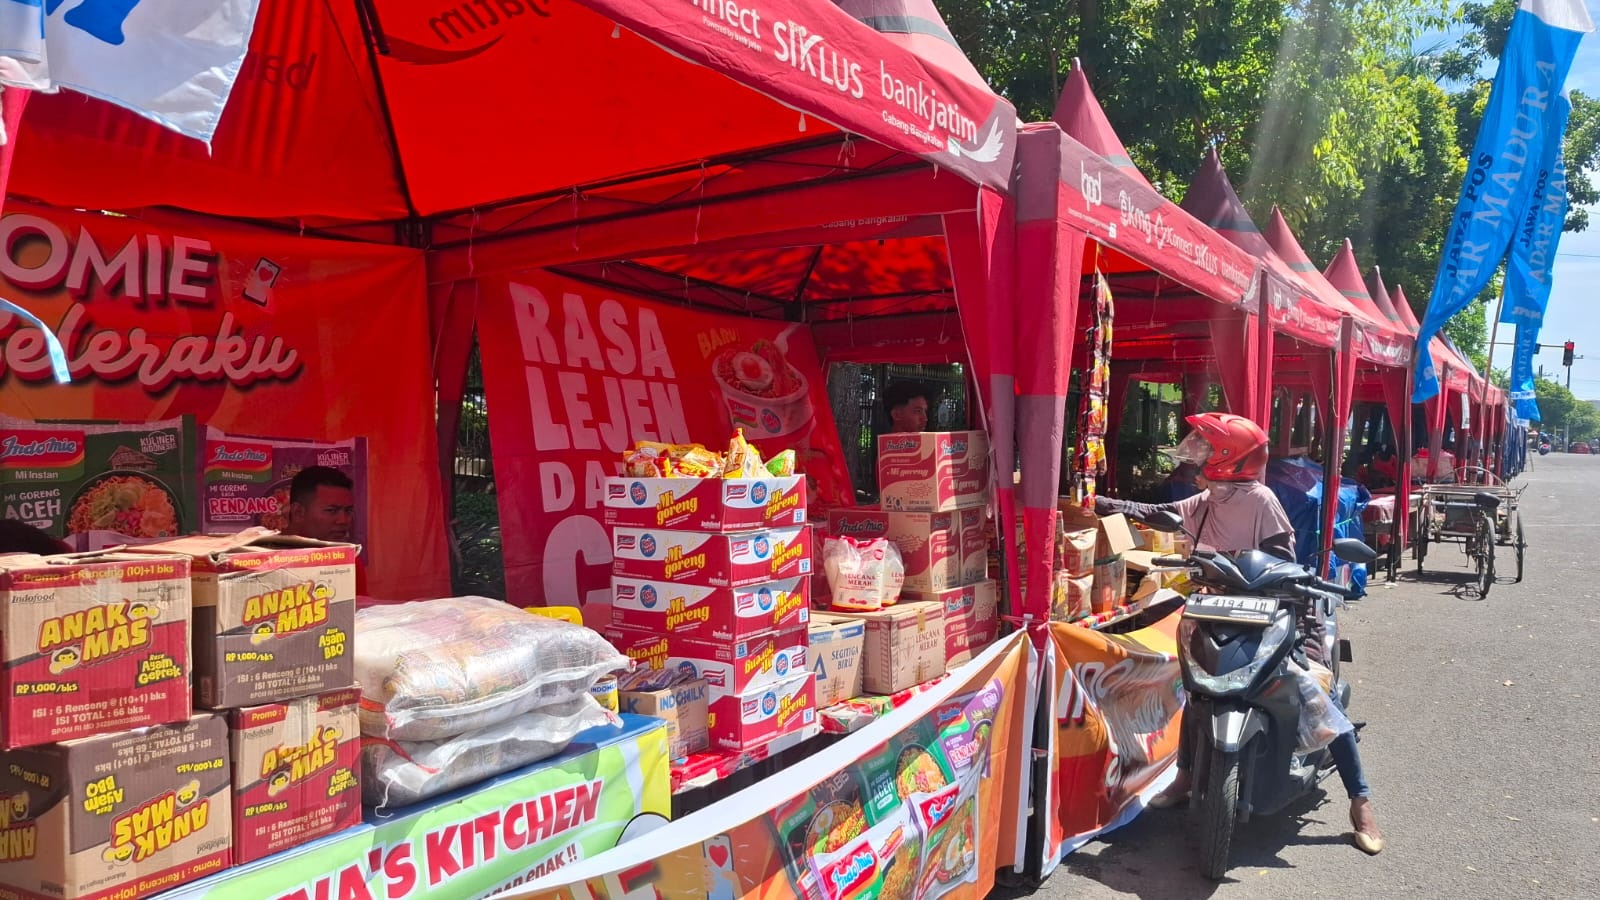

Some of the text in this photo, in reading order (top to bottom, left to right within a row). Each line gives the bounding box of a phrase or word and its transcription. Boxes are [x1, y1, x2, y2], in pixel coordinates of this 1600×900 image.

[880, 60, 977, 145] bankjatim
[882, 110, 944, 149] Cabang Bangkalan
[1473, 61, 1556, 230] MADURA
[1446, 152, 1493, 279] JAWA POS
[1520, 169, 1548, 248] JAWA POS
[509, 282, 675, 379] RASA
[697, 328, 741, 359] BARU!
[526, 366, 691, 455] LEJEN
[140, 434, 175, 447] KULINER
[15, 471, 58, 479] Mi Instan
[19, 489, 61, 500] GORENG
[657, 490, 674, 510] Mi
[5, 499, 61, 520] ACEH
[209, 497, 278, 514] RENDANG
[657, 497, 698, 525] goreng
[765, 493, 798, 519] goreng
[233, 559, 262, 568] Promo
[332, 552, 345, 560] bks
[664, 545, 682, 563] Mi
[771, 543, 802, 573] goreng
[772, 541, 785, 559] Mi
[157, 565, 174, 574] bks
[665, 553, 706, 579] goreng
[11, 592, 56, 604] Indofood
[244, 583, 312, 623] ANAK
[667, 598, 685, 615] Mi
[1213, 600, 1244, 608] 4194
[276, 599, 328, 635] MAS
[666, 606, 710, 631] goreng
[774, 593, 801, 624] goreng
[40, 602, 128, 649] ANAK
[82, 618, 148, 661] MAS
[319, 632, 345, 648] Ayam
[915, 629, 940, 644] LENCANA
[920, 639, 938, 651] MERAH
[324, 644, 344, 660] BBQ
[832, 646, 859, 660] SEGITIGA
[142, 659, 173, 673] Ayam
[238, 675, 249, 683] ISI
[325, 662, 338, 671] bks
[838, 658, 853, 670] BIRU
[138, 666, 182, 684] Geprek
[255, 681, 266, 690] ISI
[269, 679, 291, 688] TOTAL
[307, 674, 320, 683] bks
[16, 685, 29, 694] RP
[660, 685, 705, 711] INDOMILK
[33, 708, 47, 718] ISI
[56, 707, 62, 715] 6
[65, 700, 107, 714] Renceng
[150, 691, 167, 700] bks
[777, 695, 791, 715] Mi
[777, 694, 806, 728] goreng
[56, 717, 69, 726] ISI
[73, 712, 105, 724] TOTAL
[114, 710, 125, 718] 66
[127, 706, 143, 715] bks
[252, 711, 278, 721] Promo
[118, 733, 194, 756] ISI TOTAL 66 bks
[152, 744, 187, 758] Renceng
[200, 738, 212, 748] ISI
[949, 740, 979, 761] RENDANG
[95, 763, 111, 773] bks
[213, 759, 223, 767] RP
[291, 741, 335, 783] MAS
[86, 775, 116, 796] BBQ
[873, 777, 894, 803] ACEH
[84, 788, 124, 811] Ayam
[115, 795, 175, 847] MAS
[245, 807, 255, 816] RP
[136, 800, 209, 861] ANAK
[256, 827, 266, 836] ISI
[271, 831, 281, 840] ISI
[283, 825, 306, 837] TOTAL
[320, 815, 332, 824] bks
[427, 781, 603, 887] KITCHEN
[192, 858, 221, 873] Promo
[139, 872, 180, 891] Renceng
